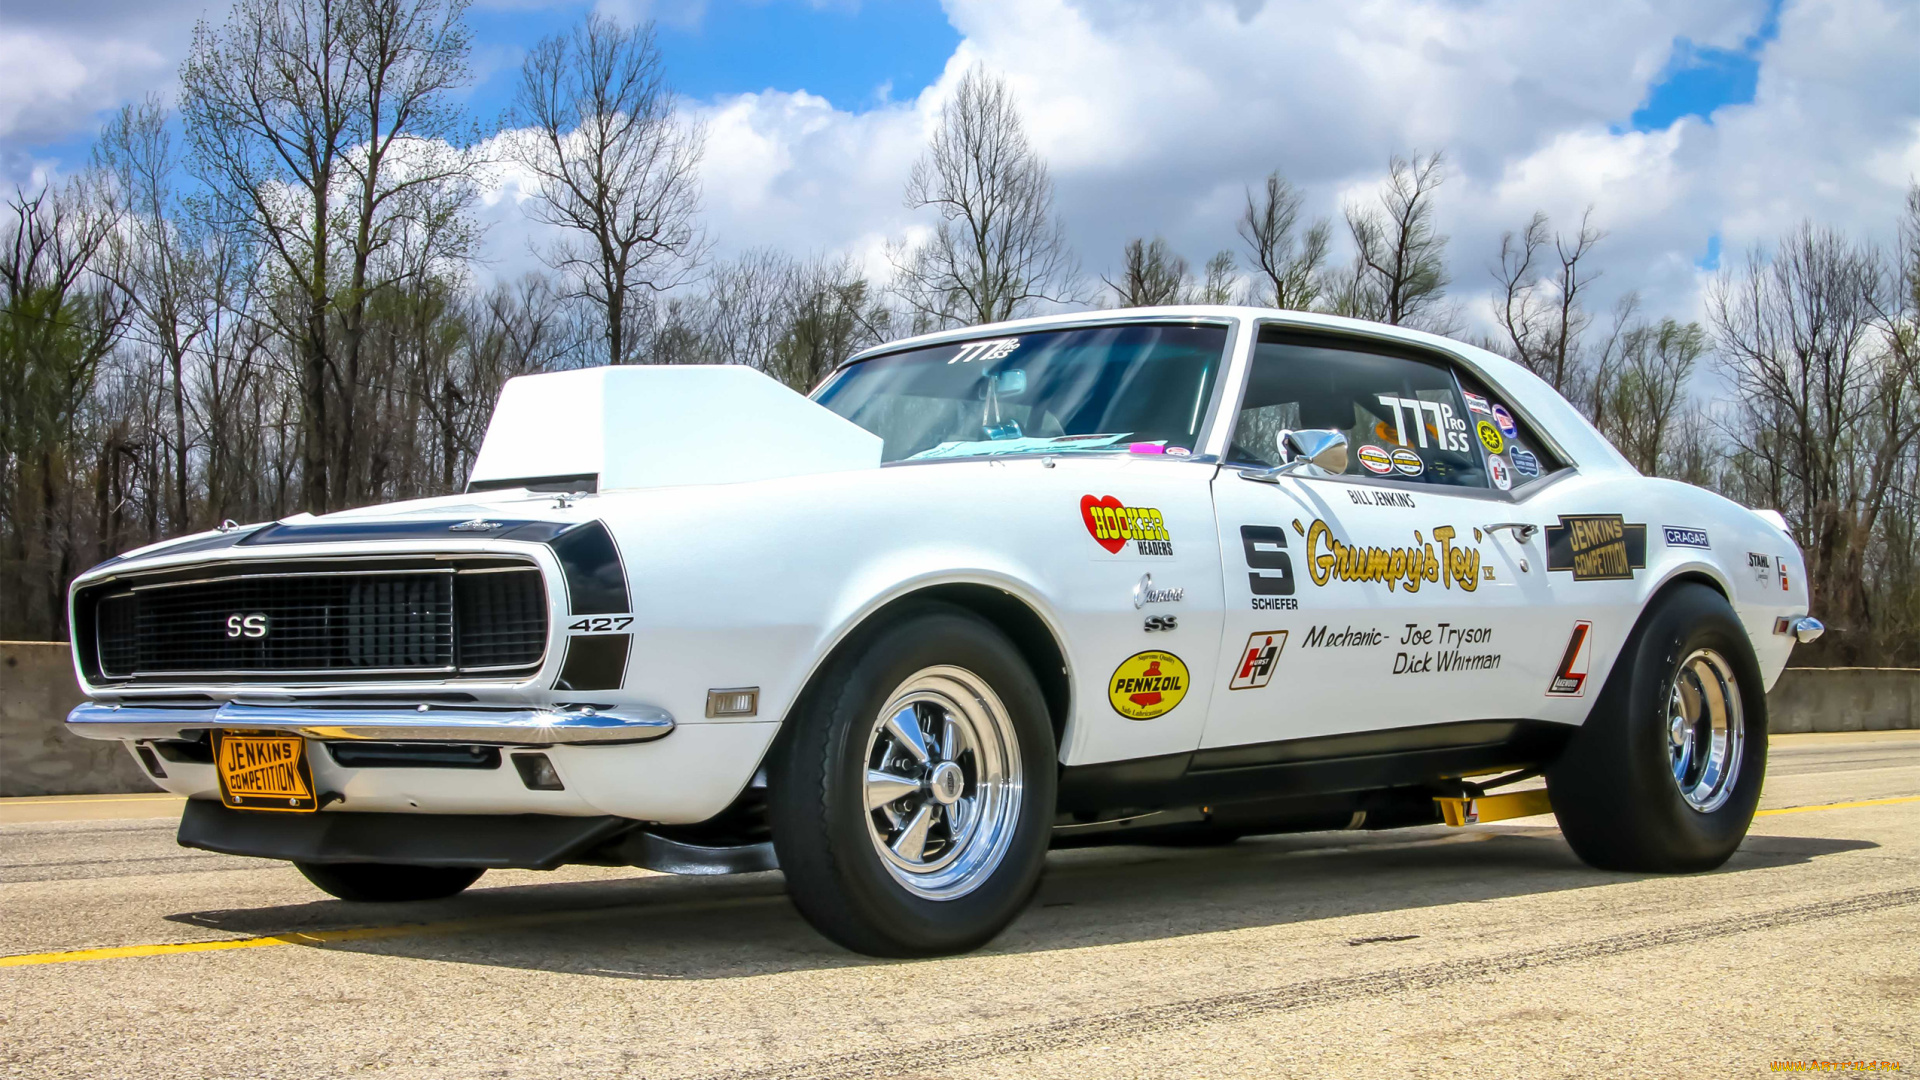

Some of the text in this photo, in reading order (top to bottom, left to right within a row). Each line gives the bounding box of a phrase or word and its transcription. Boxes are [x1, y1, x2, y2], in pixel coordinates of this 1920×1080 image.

[947, 339, 1010, 364] 777
[1378, 396, 1448, 451] 777
[1441, 402, 1467, 432] PRO
[1449, 432, 1470, 453] SS
[1347, 489, 1416, 508] BILL JENKINS
[1090, 506, 1170, 541] HOOKER
[1569, 520, 1623, 552] JENKINS
[1666, 530, 1708, 545] CRAGAR
[1138, 541, 1173, 556] HEADERS
[1574, 540, 1629, 576] COMPETITION
[1749, 552, 1770, 568] STAHL
[1251, 598, 1298, 610] SCHIEFER
[227, 615, 267, 637] SS
[568, 617, 634, 632] 427
[1144, 614, 1178, 633] SS
[1400, 624, 1433, 645] Joe
[1438, 623, 1492, 648] Tryson
[1160, 654, 1175, 664] Quality
[1393, 650, 1501, 674] Dick Whitman
[1115, 676, 1182, 693] PENNZOIL
[228, 742, 292, 772] JENKINS
[230, 761, 296, 791] COMPETITION
